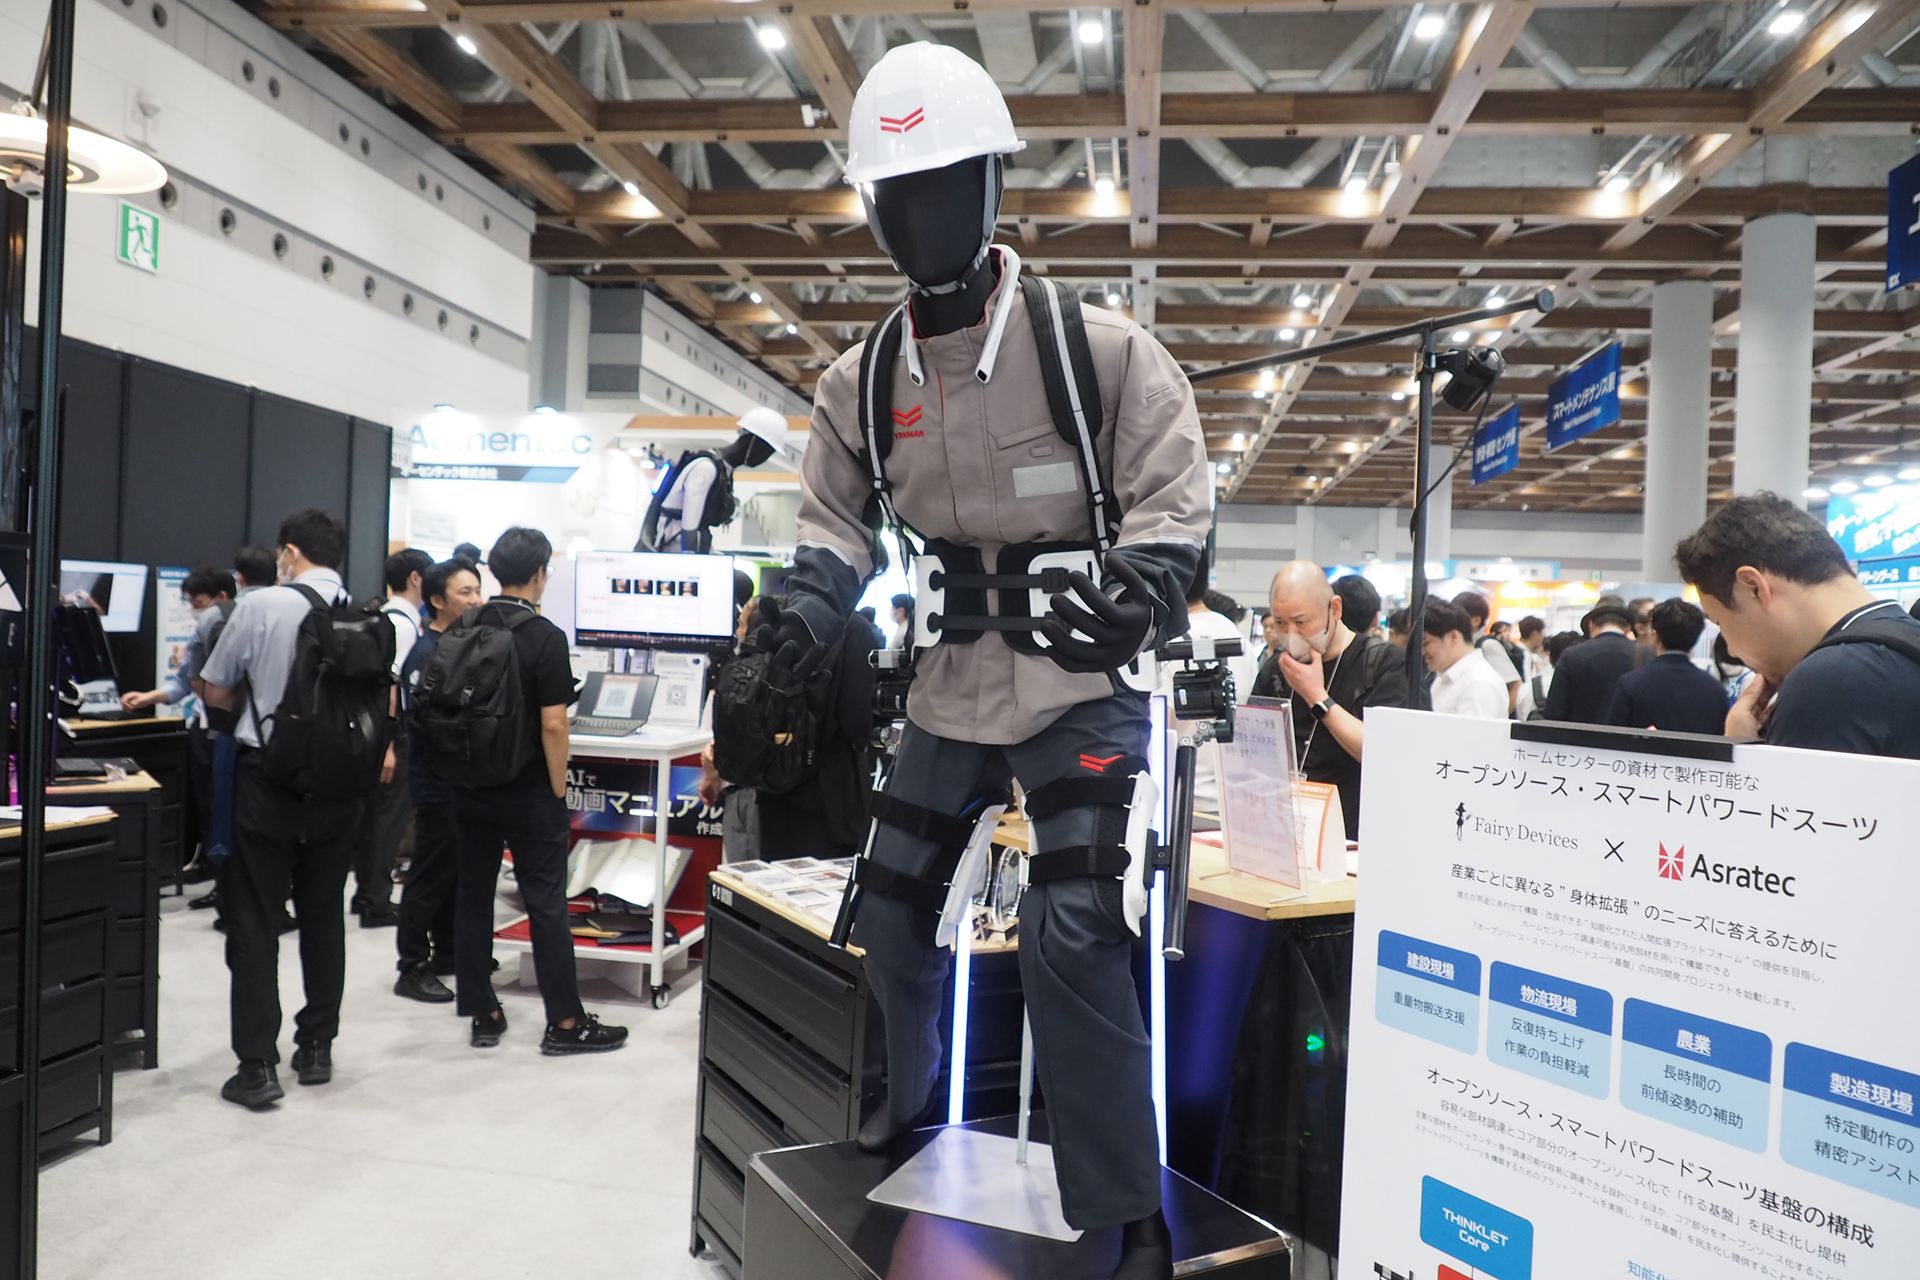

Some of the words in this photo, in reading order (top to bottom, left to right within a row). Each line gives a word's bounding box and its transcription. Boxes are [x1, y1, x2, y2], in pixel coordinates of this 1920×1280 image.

[894, 429, 926, 440] YANMAR
[565, 768, 597, 787] AIで
[1513, 746, 1760, 792] ホームセンターの資材で製作可能な
[1436, 759, 1878, 841] オープンソース・スマートパワードスーツ
[696, 821, 724, 837] 作成
[1475, 816, 1513, 841] Fairy
[1517, 824, 1579, 850] Devices
[1690, 853, 1796, 898] Asratec
[1406, 951, 1454, 980] 建設現場
[1393, 991, 1466, 1025] 重量物搬送支援
[1520, 984, 1578, 1017] 物流現場
[1511, 1016, 1585, 1050] 反復持ち上げ
[1676, 1028, 1711, 1056] 農業
[1504, 1038, 1590, 1079] 作業の負担軽減
[1663, 1064, 1722, 1094] 長時間の
[1829, 1072, 1914, 1116] 製造現場
[1641, 1083, 1744, 1130] 前傾姿勢の補助
[1824, 1113, 1915, 1154] 特定動作の
[1427, 1068, 1875, 1249] オープンソース・スマートパワードスーツ基盤の構成
[1814, 1138, 1920, 1185] 精密アシスト
[1440, 1099, 1848, 1268] 容易な部材調達とコア部分のオープンソース化で「作る基盤」を民主化し提供
[1442, 1207, 1509, 1247] THINKLET
[1459, 1229, 1491, 1252] Core
